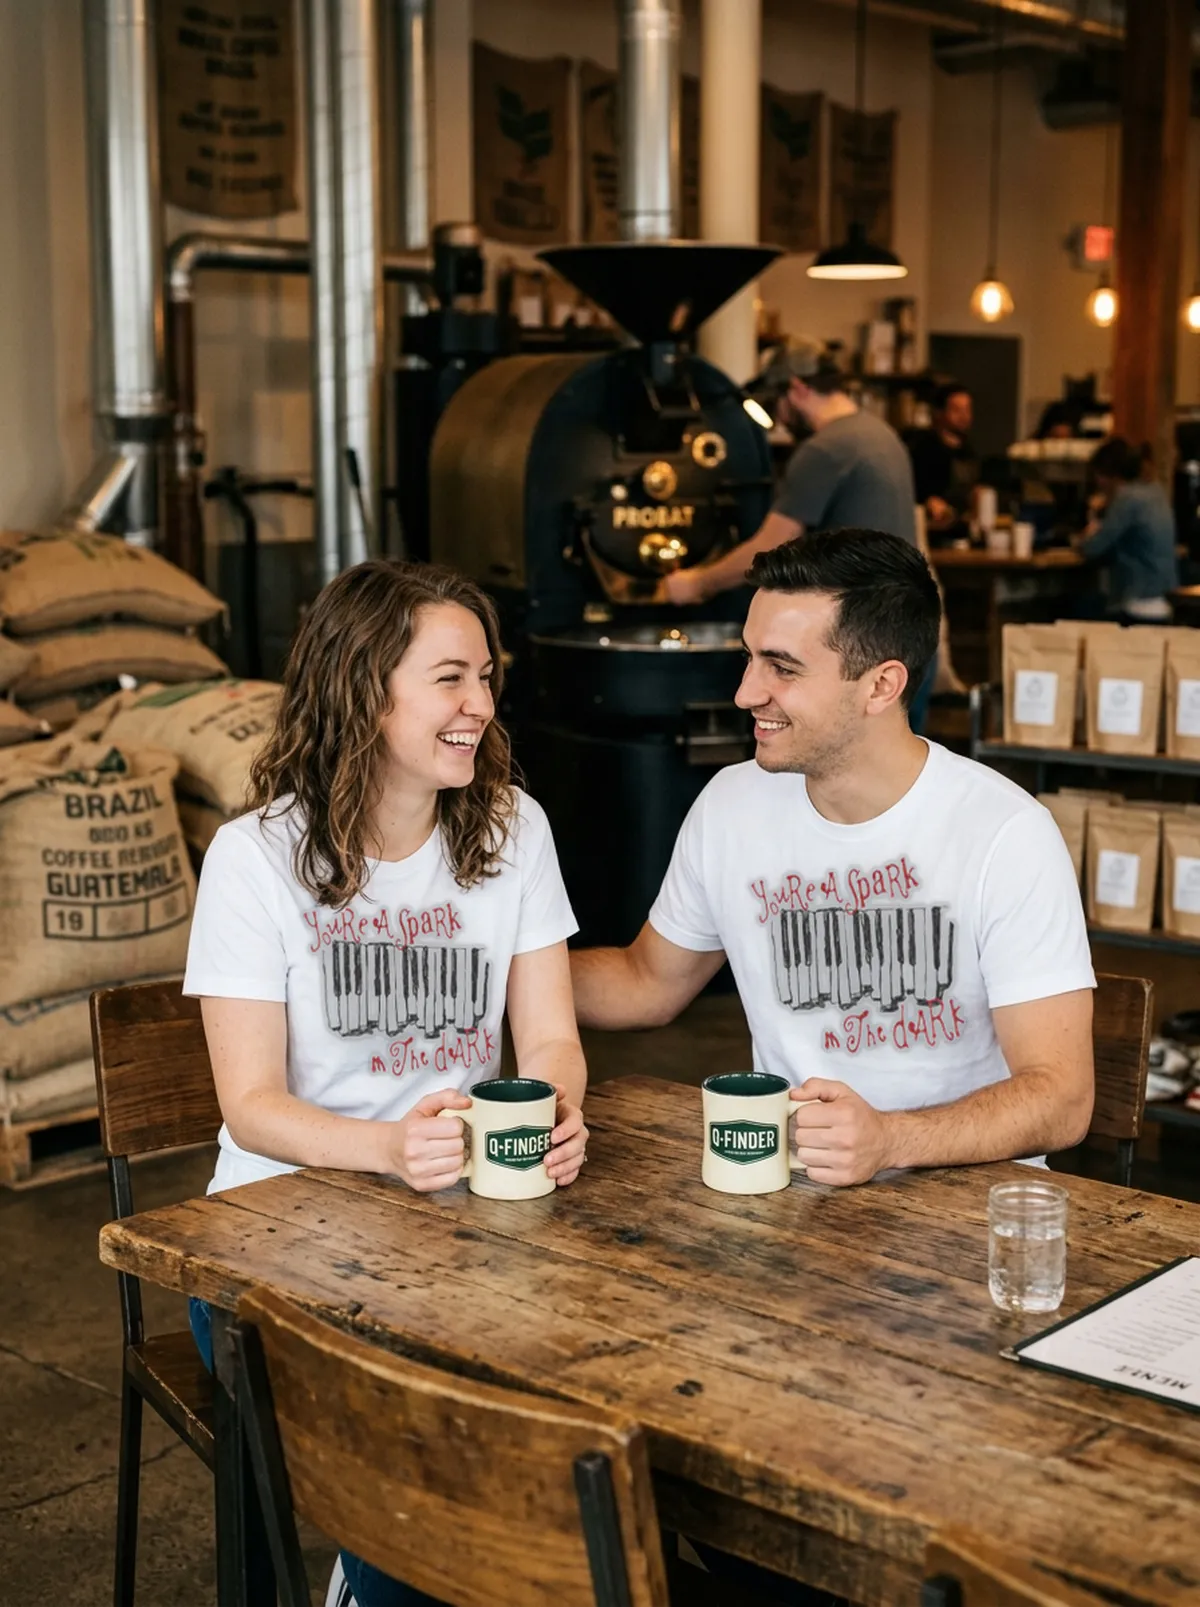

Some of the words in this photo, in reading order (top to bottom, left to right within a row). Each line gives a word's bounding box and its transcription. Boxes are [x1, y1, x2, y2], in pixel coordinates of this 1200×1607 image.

[65, 786, 162, 819] BRAZIL
[42, 850, 113, 869] COFFEE
[46, 855, 182, 898] GUATEMALA
[56, 910, 84, 932] 19
